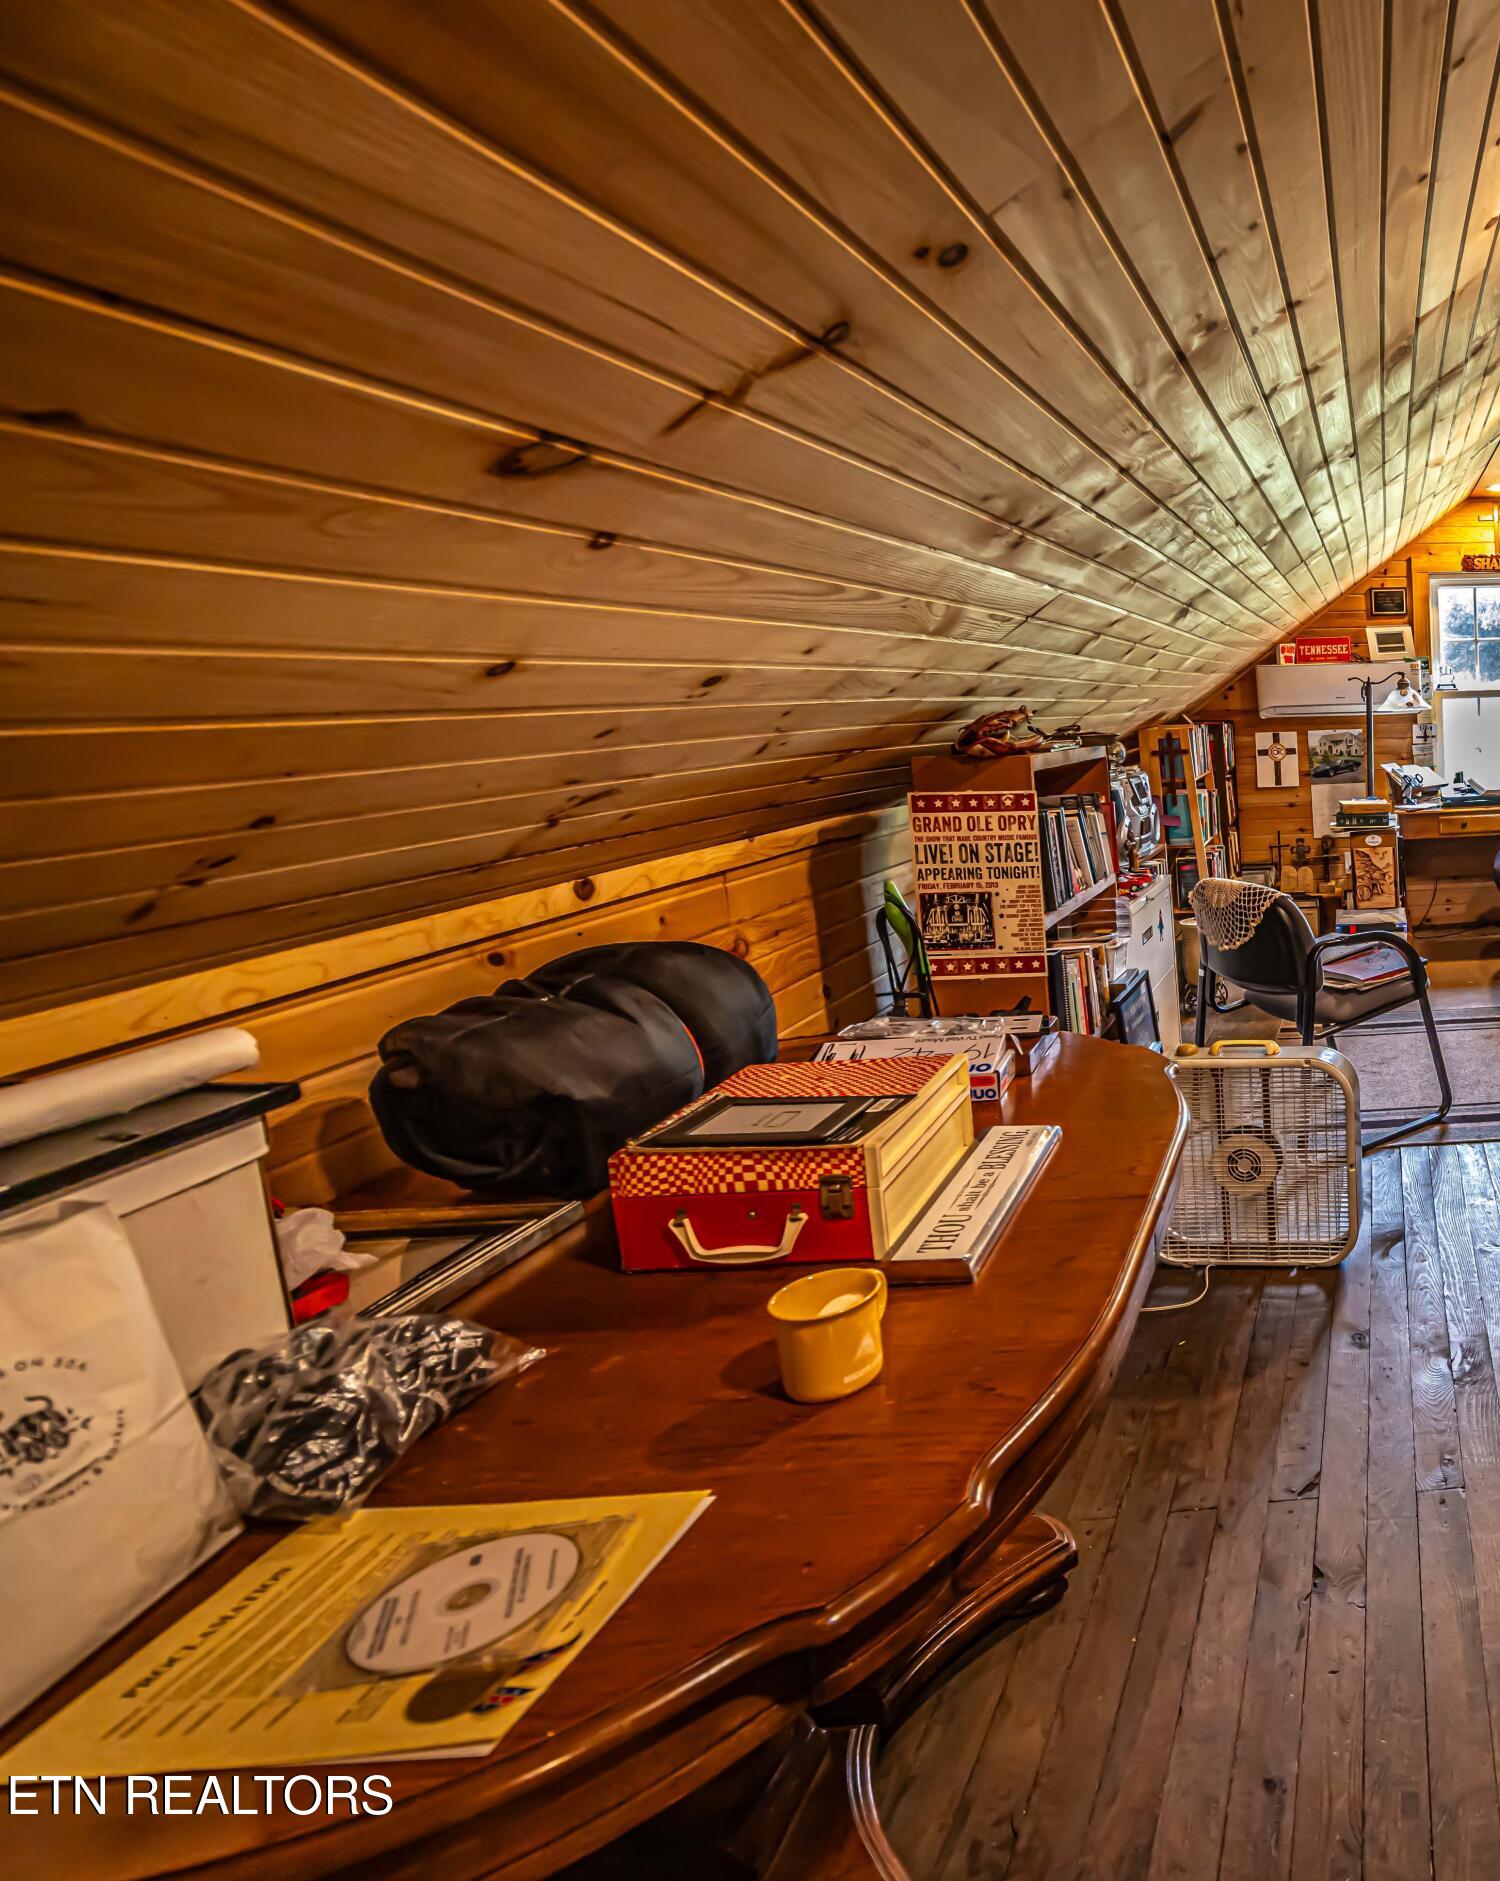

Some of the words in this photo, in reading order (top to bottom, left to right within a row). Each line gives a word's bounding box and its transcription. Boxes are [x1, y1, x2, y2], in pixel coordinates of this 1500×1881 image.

[1299, 644, 1349, 656] TENNESSEE
[912, 816, 962, 832] GRAND
[967, 815, 994, 832] OLE
[998, 815, 1037, 831] OPRY
[914, 843, 954, 865] LIVE!
[958, 843, 980, 864] ON
[984, 841, 1039, 863] STAGE!
[917, 866, 983, 881] APPEARING
[985, 865, 1040, 880] TONIGHT!
[977, 1129, 1030, 1170] BLESSING.
[976, 1178, 989, 1192] be
[958, 1188, 982, 1211] shalt
[916, 1214, 972, 1253] THOU
